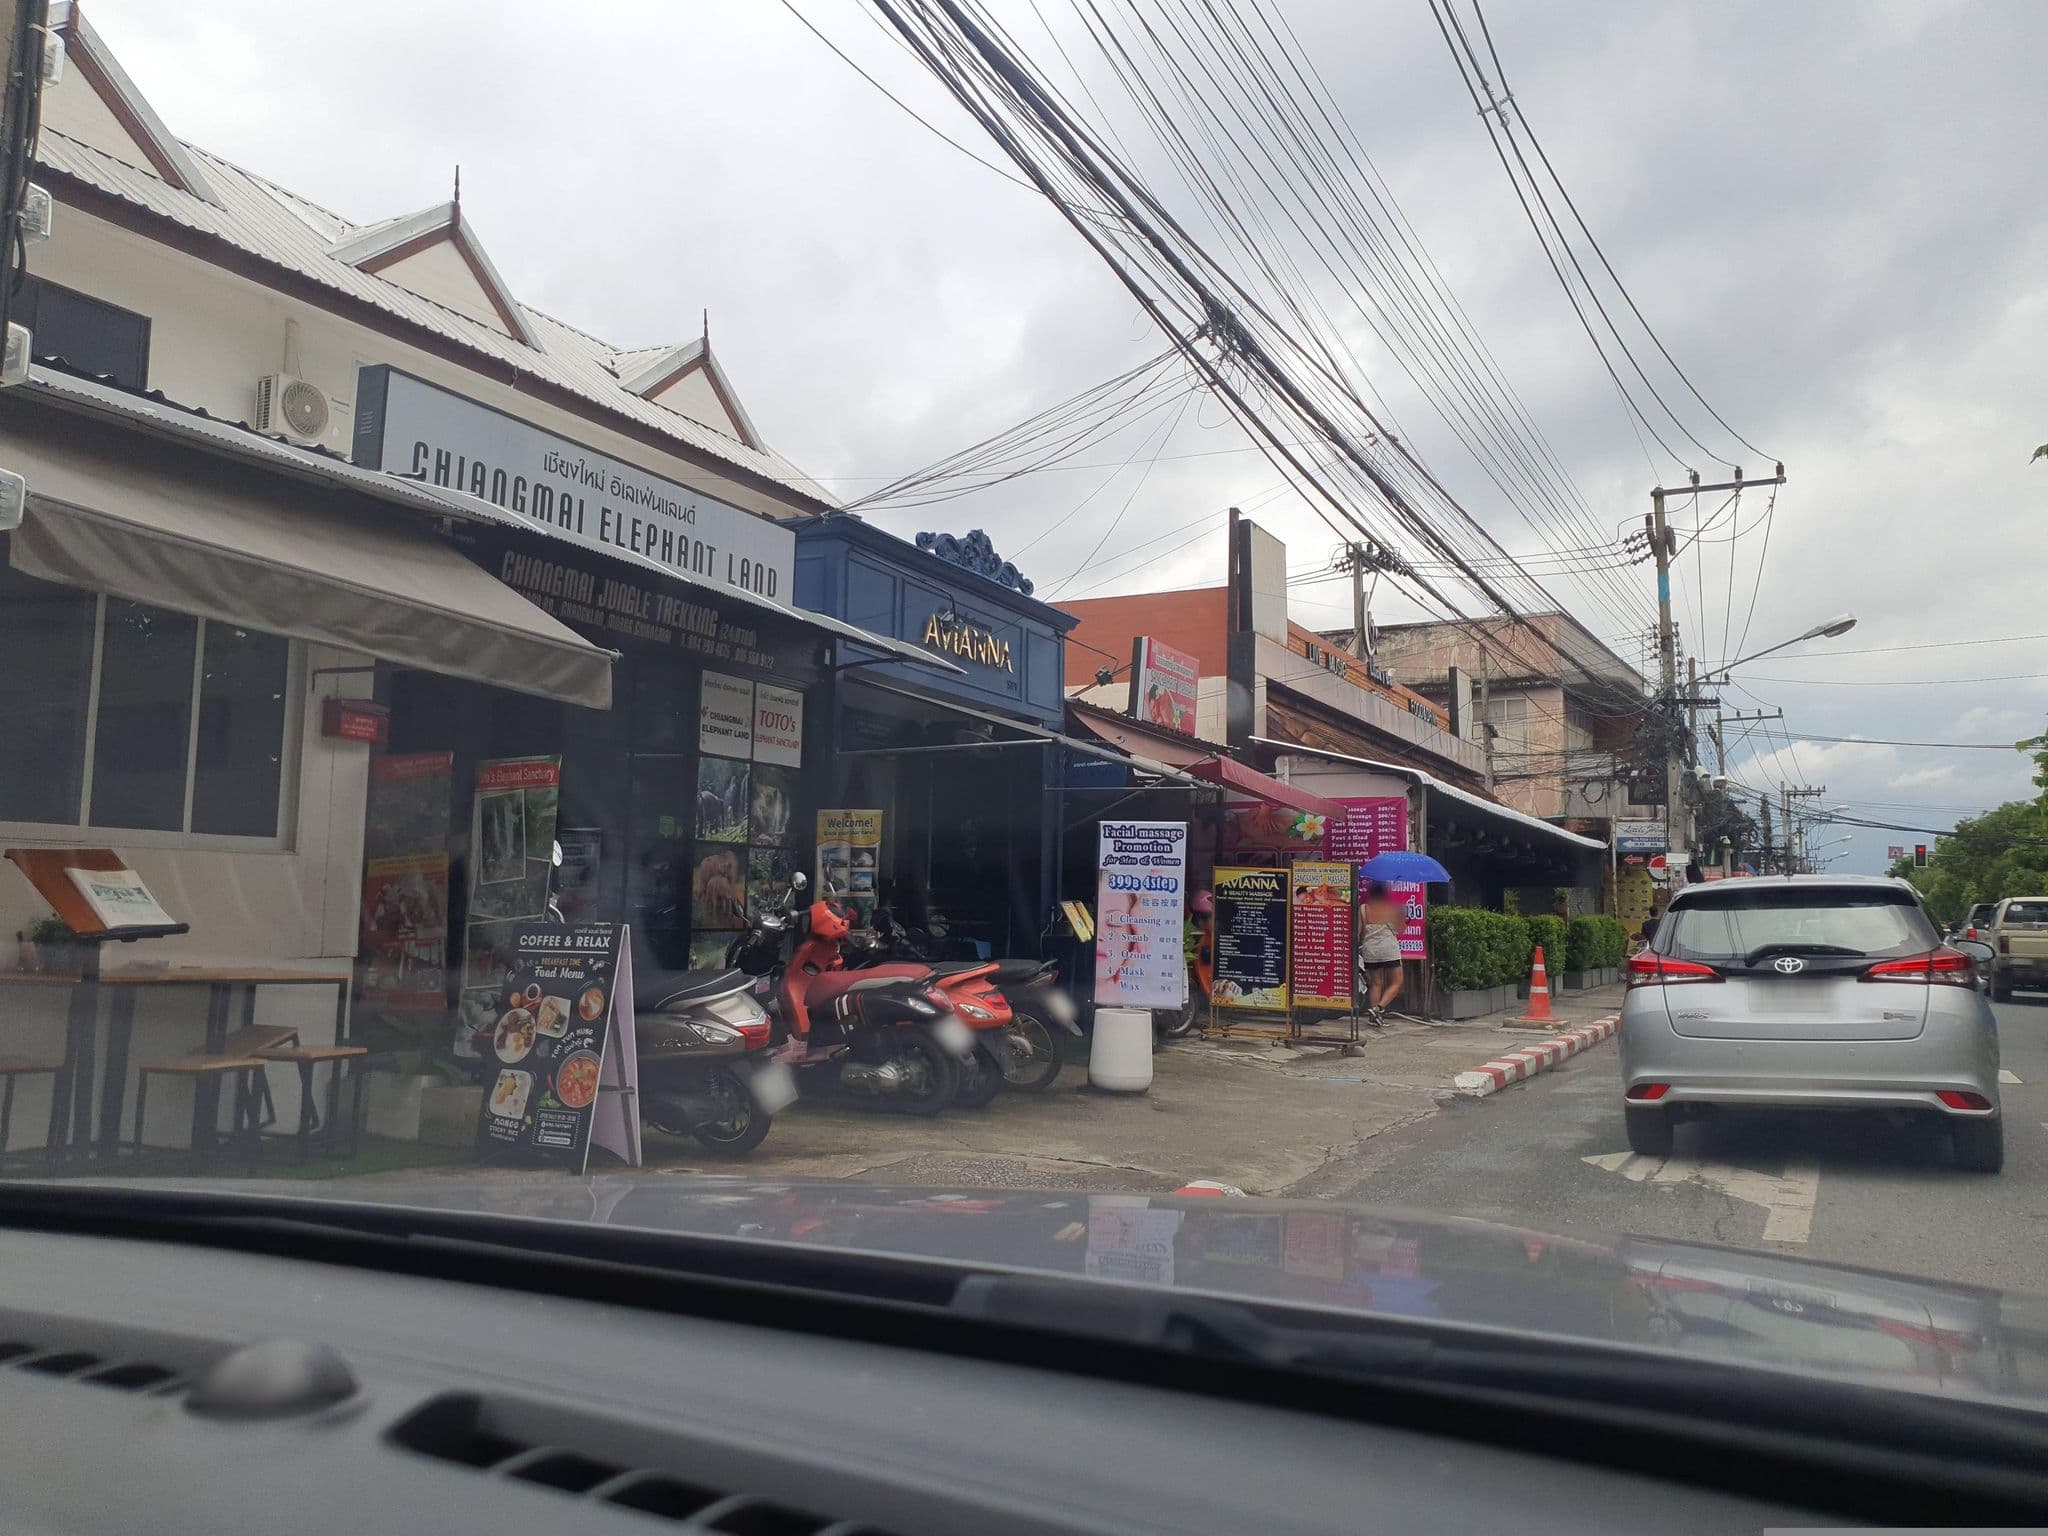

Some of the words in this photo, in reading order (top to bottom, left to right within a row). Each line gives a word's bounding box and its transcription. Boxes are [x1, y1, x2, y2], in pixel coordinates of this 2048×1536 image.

[544, 451, 606, 491] เชียงใหม่
[412, 441, 584, 534] CHIANGMAI
[600, 507, 717, 577] ELEPHANT
[727, 552, 779, 598] LAND
[502, 550, 595, 604] CHIANGMAI
[598, 578, 652, 619] JUNGLE
[655, 594, 719, 636] TREKKING
[759, 710, 796, 733] TOTO's
[827, 817, 873, 829] Welcome!
[1103, 825, 1136, 839] Facial
[1136, 828, 1184, 843] massage
[1113, 840, 1173, 853] Promotion
[1102, 854, 1119, 866] for
[1150, 855, 1182, 866] Women
[1143, 875, 1178, 893] 4step
[1222, 878, 1280, 890] AVIANNA
[1120, 914, 1161, 927] Cleansing
[519, 934, 561, 947] COFFEE
[564, 935, 572, 947] &
[575, 936, 611, 948] RELAX
[1121, 932, 1149, 942] Scrub
[1121, 949, 1152, 960] Ozone
[535, 965, 557, 978] Food
[559, 967, 585, 979] Menu
[1120, 967, 1145, 977] Mask
